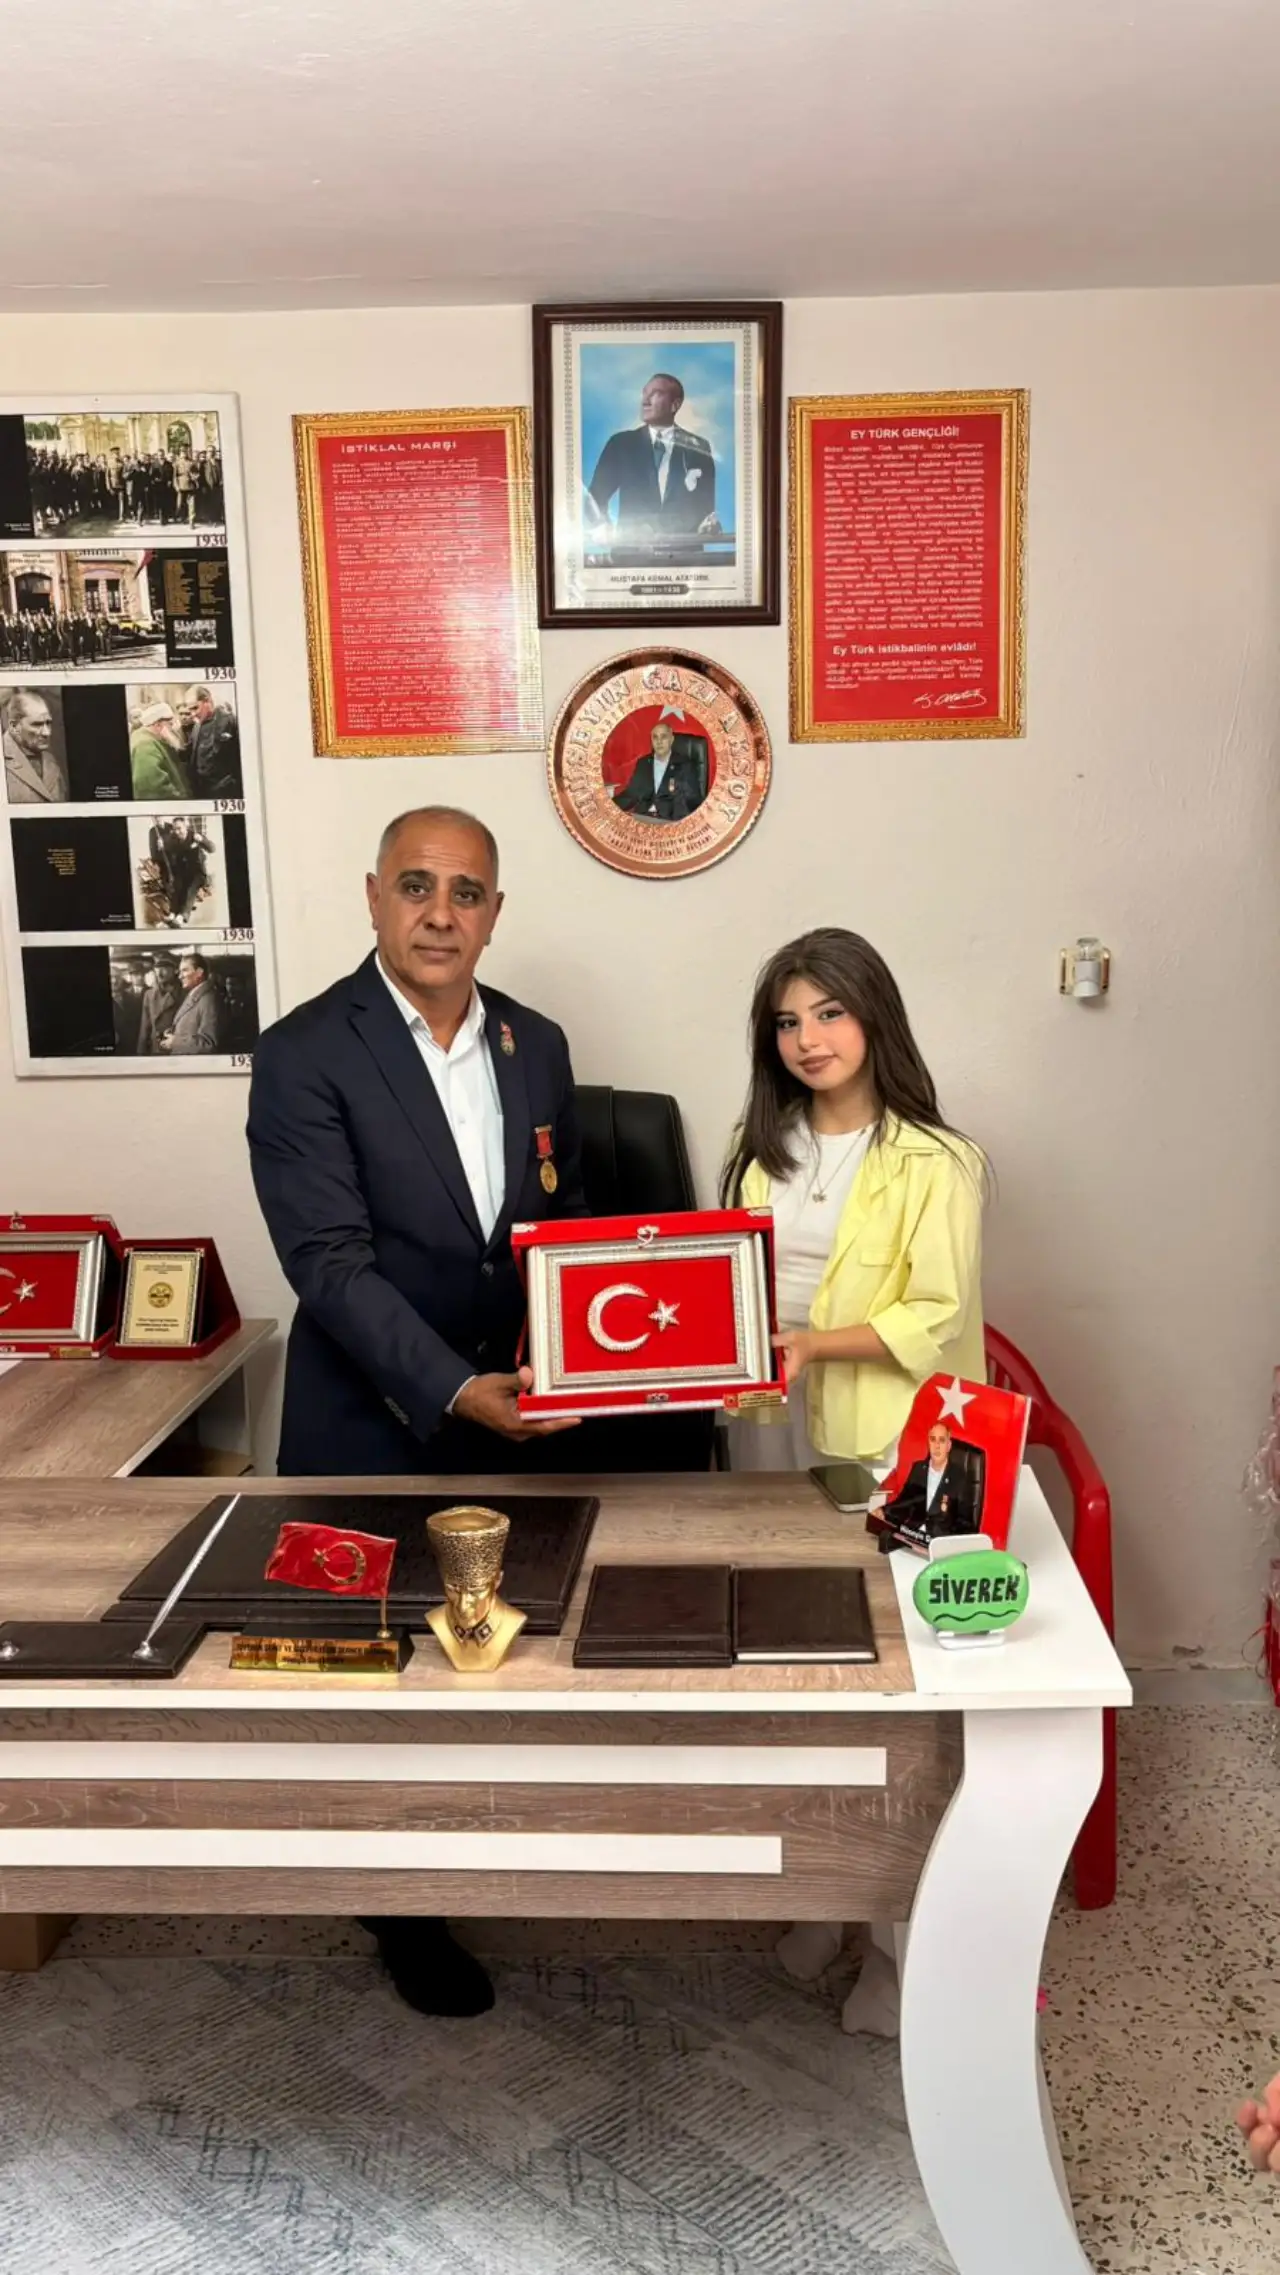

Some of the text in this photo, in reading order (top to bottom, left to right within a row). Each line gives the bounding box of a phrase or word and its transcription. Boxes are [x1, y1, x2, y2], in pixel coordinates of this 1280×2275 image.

[851, 430, 865, 440] EY
[869, 427, 899, 439] TÜRK
[196, 534, 228, 548] 1930
[832, 645, 847, 657] Ey
[851, 644, 875, 654] Türk
[205, 667, 237, 680] 1930
[213, 799, 246, 812] 1930
[223, 928, 254, 941] 1930
[929, 1573, 1020, 1605] SİVEREK
